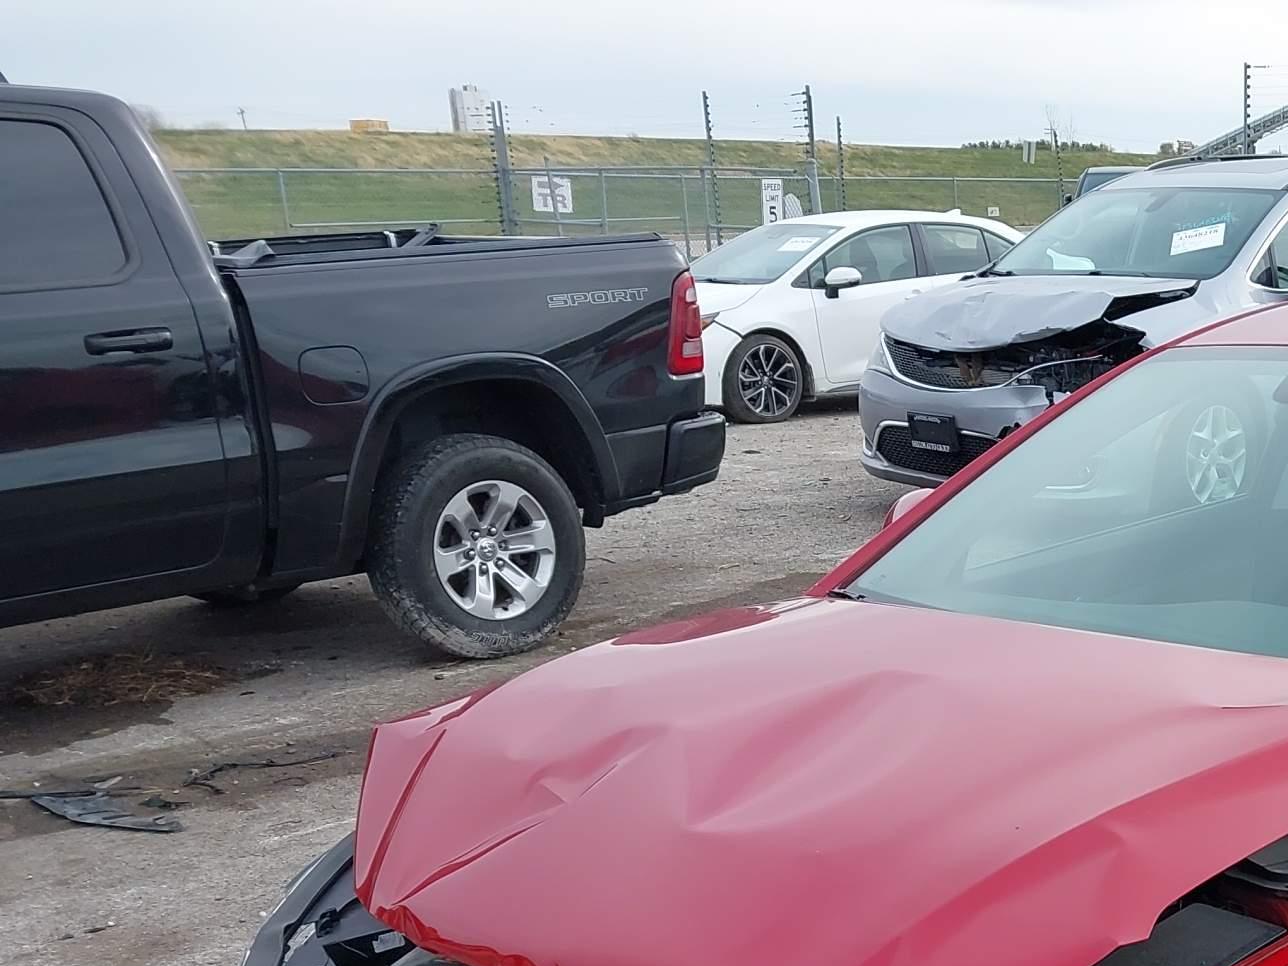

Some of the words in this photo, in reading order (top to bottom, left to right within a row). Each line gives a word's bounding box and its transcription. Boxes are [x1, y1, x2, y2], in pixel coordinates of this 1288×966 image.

[763, 183, 781, 191] SPEED
[765, 194, 779, 202] LIMIT
[769, 206, 777, 223] 5
[546, 287, 648, 309] SPORT
